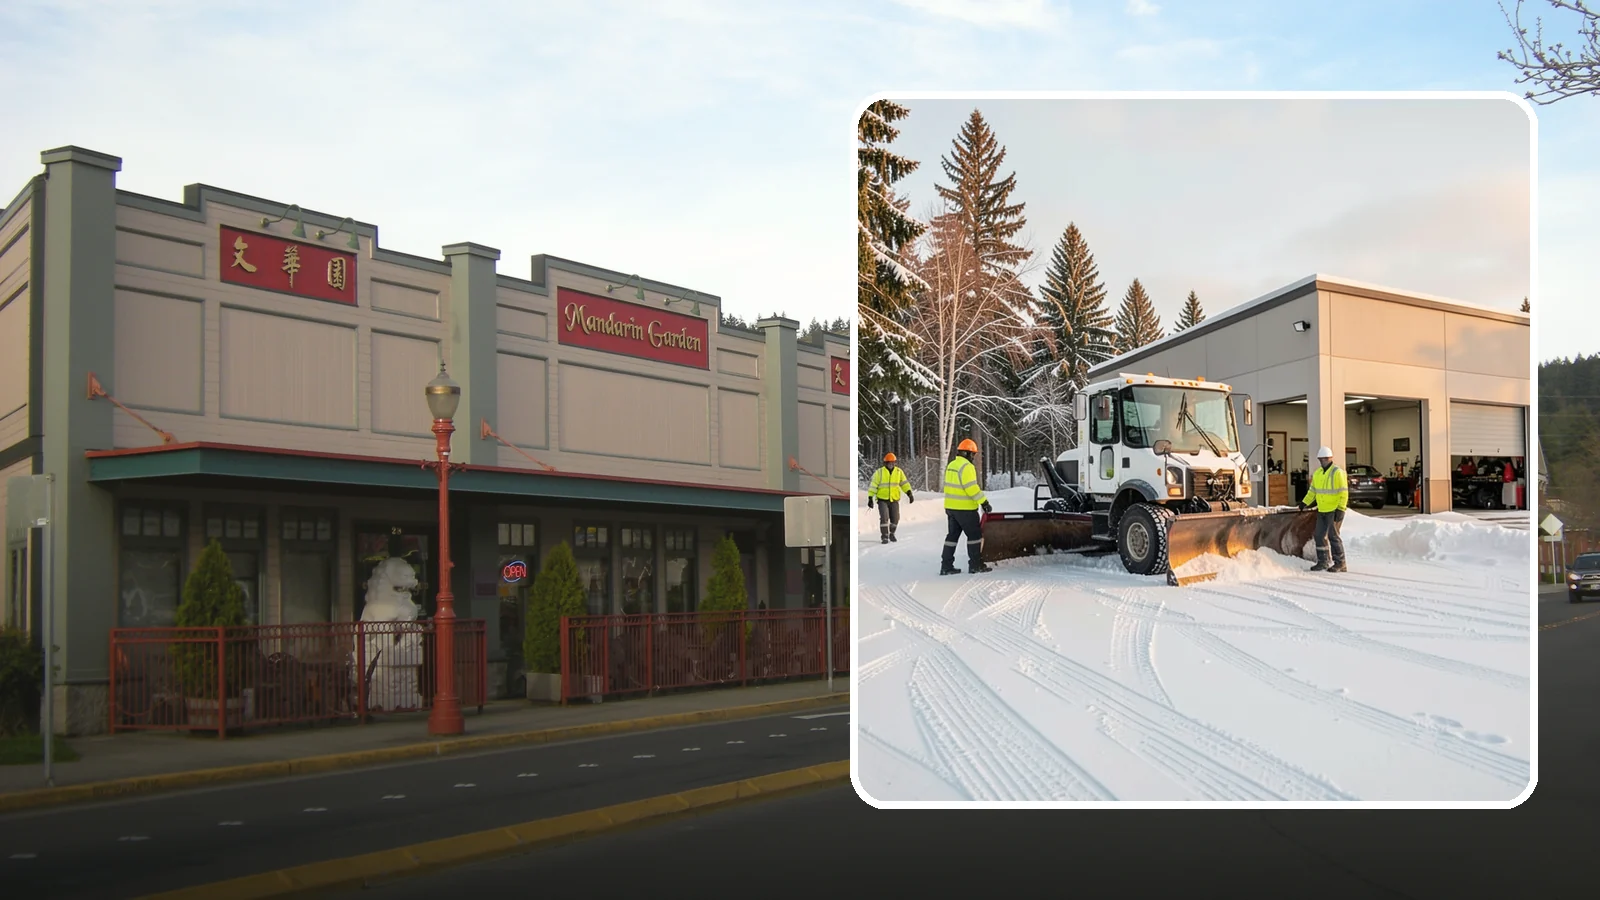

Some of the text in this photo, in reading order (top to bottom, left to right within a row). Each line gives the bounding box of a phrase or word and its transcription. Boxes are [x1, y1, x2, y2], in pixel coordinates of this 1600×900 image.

[231, 236, 346, 291] 文華園
[564, 302, 702, 352] Mandarin Garden
[503, 565, 526, 578] OPEN
